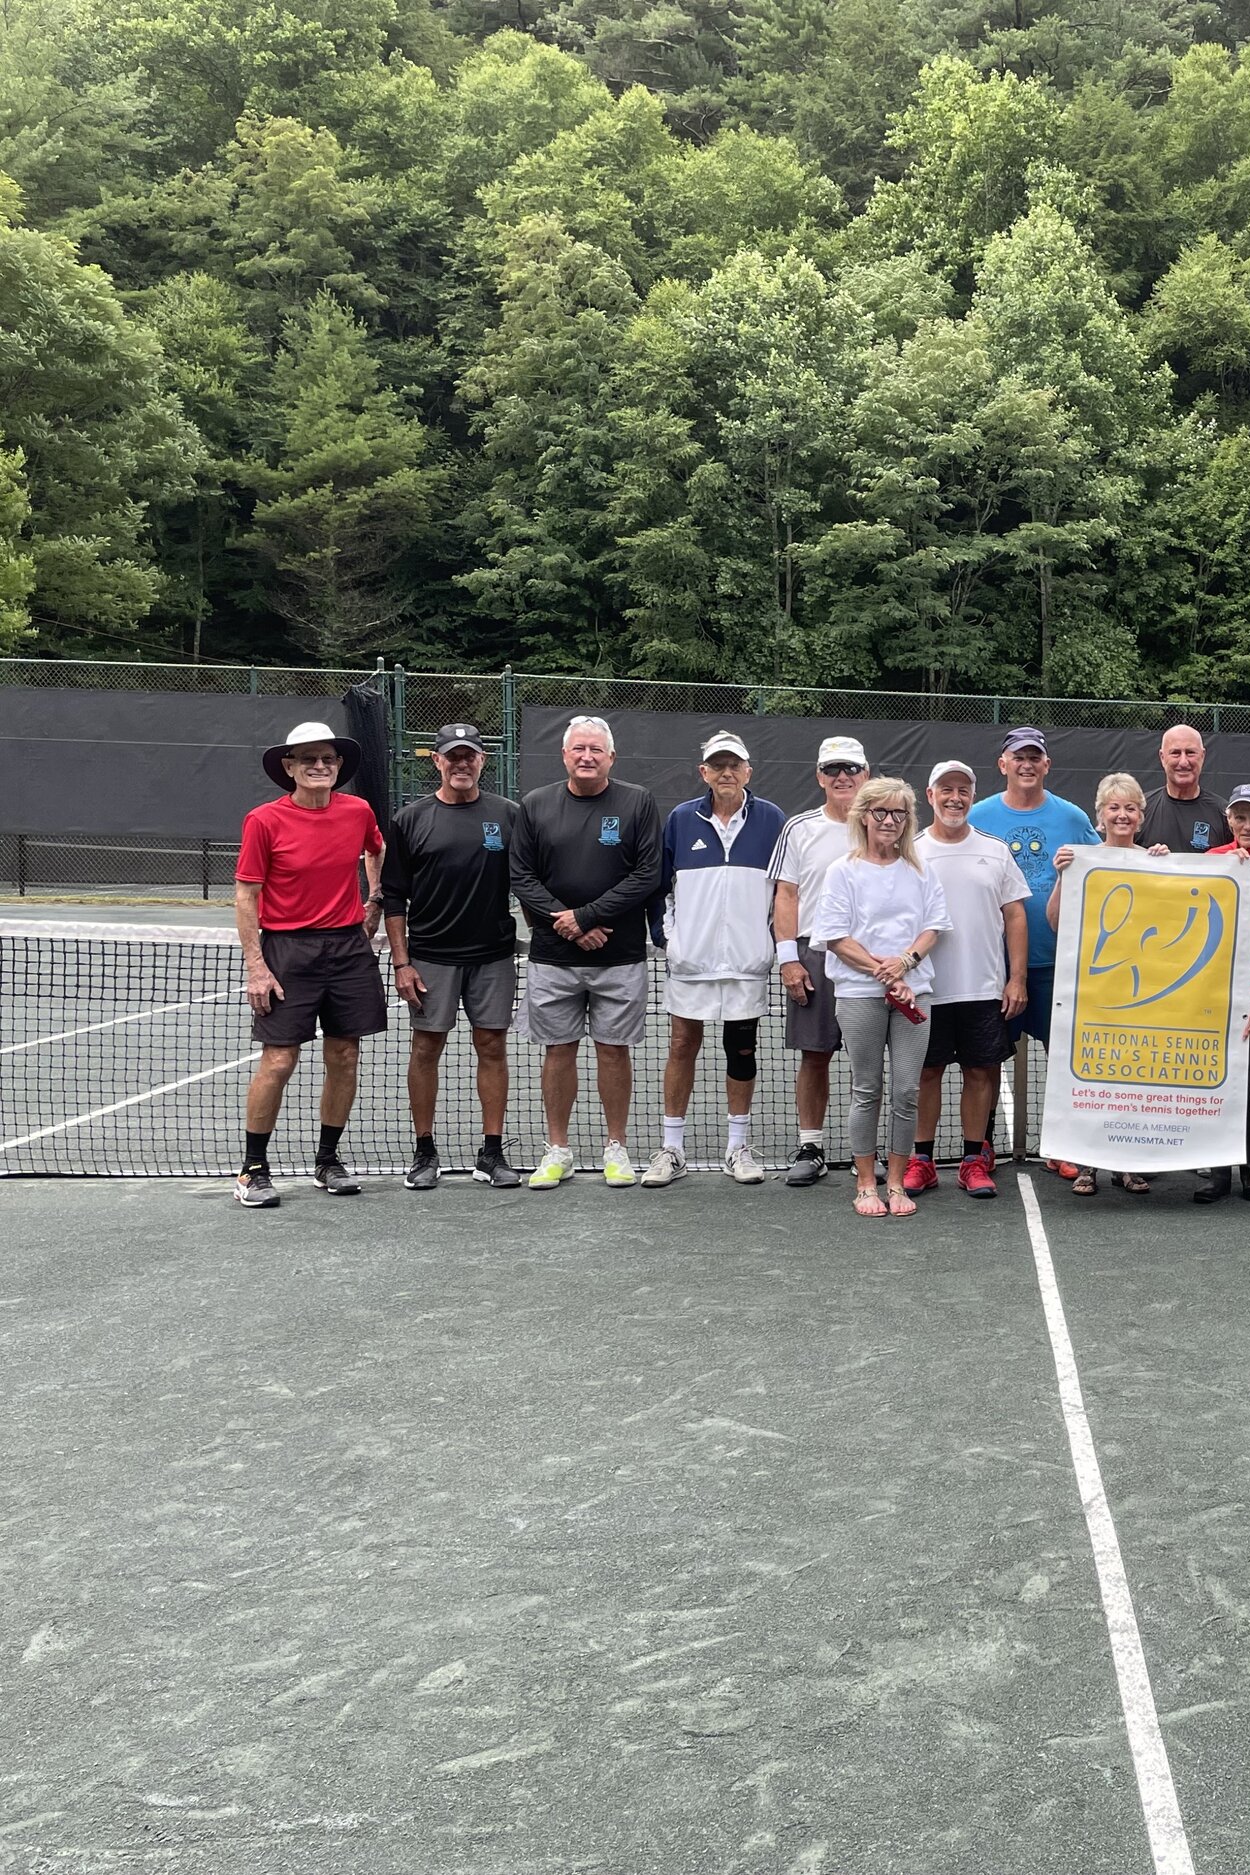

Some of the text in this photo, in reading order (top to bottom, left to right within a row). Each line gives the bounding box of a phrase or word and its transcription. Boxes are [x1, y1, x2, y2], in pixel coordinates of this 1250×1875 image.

[1082, 1031, 1219, 1050] NATIONAL SENIOR
[1082, 1047, 1218, 1066] MEN'S TENNIS
[1081, 1062, 1218, 1082] ASSOCIATION
[1072, 1088, 1224, 1105] Let's do some great things for
[1073, 1101, 1221, 1116] senior men's tennis together!
[1104, 1121, 1140, 1130] BECOME
[1151, 1125, 1190, 1133] MEMBER!
[1108, 1135, 1184, 1146] WWW.NSMTA.NET
